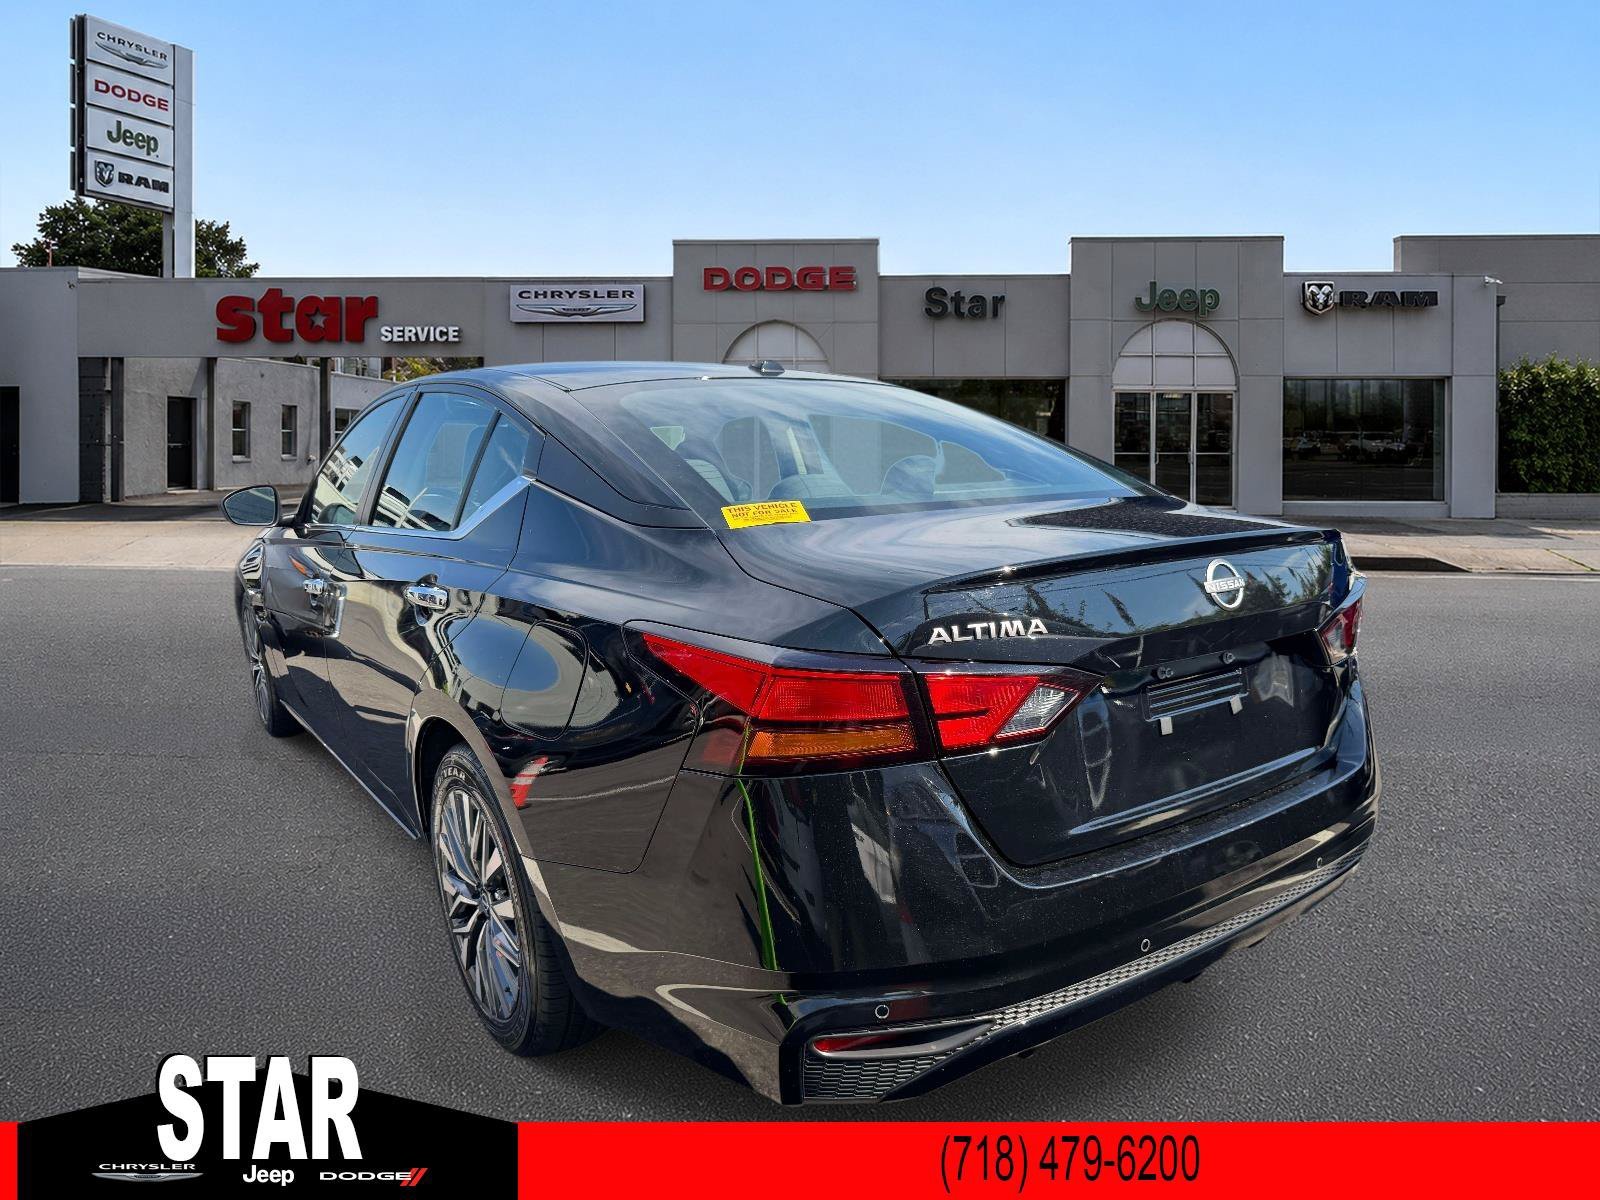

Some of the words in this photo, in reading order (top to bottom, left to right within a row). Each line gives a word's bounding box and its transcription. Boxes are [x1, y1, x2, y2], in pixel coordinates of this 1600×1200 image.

[97, 31, 168, 62] CHRYSLER
[94, 79, 169, 111] DODGE
[106, 120, 159, 156] Jeep
[118, 171, 170, 193] RAM
[703, 266, 857, 292] DODGE
[518, 290, 635, 300] CHRYSLER
[923, 286, 1006, 319] Star
[1134, 281, 1221, 316] Jeep
[1339, 290, 1438, 308] RAM
[216, 288, 379, 343] star
[380, 326, 461, 342] SERVICE
[727, 506, 752, 514] THIS
[753, 502, 797, 510] VEHICLE
[1206, 579, 1245, 592] NISSAN
[928, 619, 1049, 645] ALTIMA
